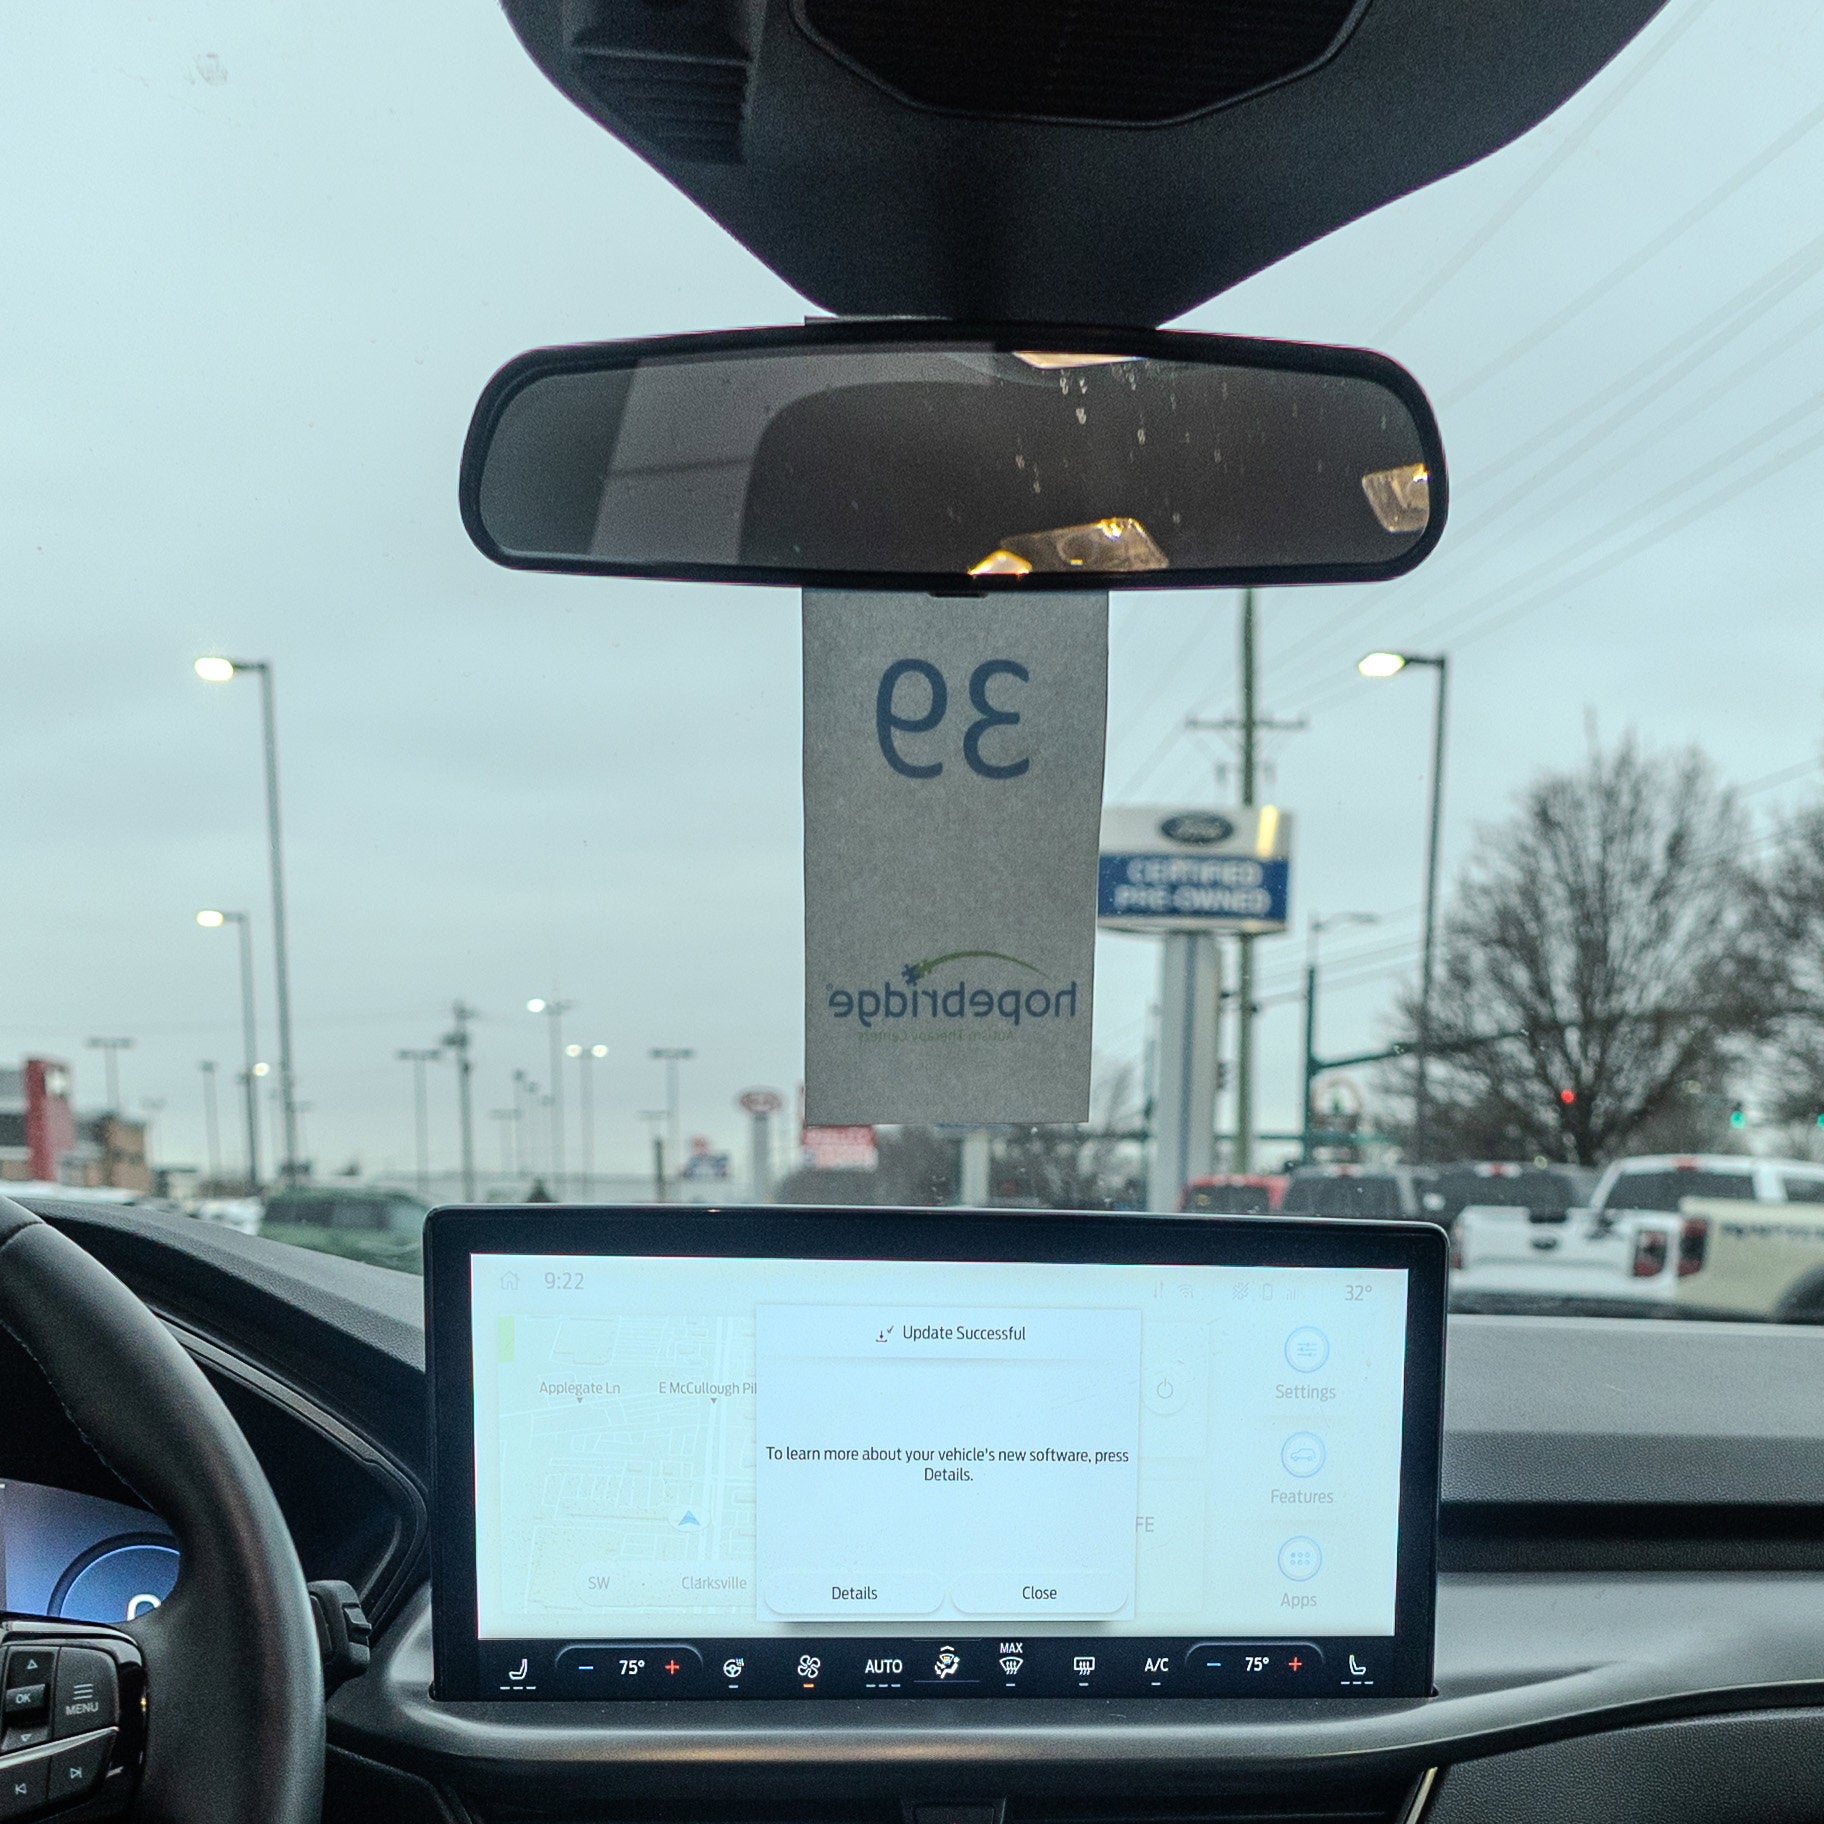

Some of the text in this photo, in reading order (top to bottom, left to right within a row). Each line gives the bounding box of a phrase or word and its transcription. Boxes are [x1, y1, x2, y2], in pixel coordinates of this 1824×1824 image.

[543, 1271, 586, 1291] 9:22
[902, 1325, 1027, 1343] Update Successful
[539, 1380, 621, 1397] Applegate Ln
[658, 1381, 667, 1395] E
[669, 1380, 740, 1397] McCullough
[1275, 1384, 1336, 1402] Settings
[766, 1445, 1129, 1465] To learn more about your vehicle's new software, press
[924, 1467, 974, 1482] Details.
[1270, 1488, 1334, 1505] Features
[588, 1575, 611, 1590] SW
[681, 1575, 747, 1590] Clarksville
[831, 1585, 878, 1601] Details
[1022, 1585, 1058, 1601] Close
[1280, 1592, 1318, 1609] Apps
[999, 1642, 1023, 1654] MAX
[864, 1659, 903, 1674] AUTO
[1144, 1656, 1169, 1673] A/C
[15, 1693, 31, 1704] OK
[65, 1702, 99, 1716] MENU
